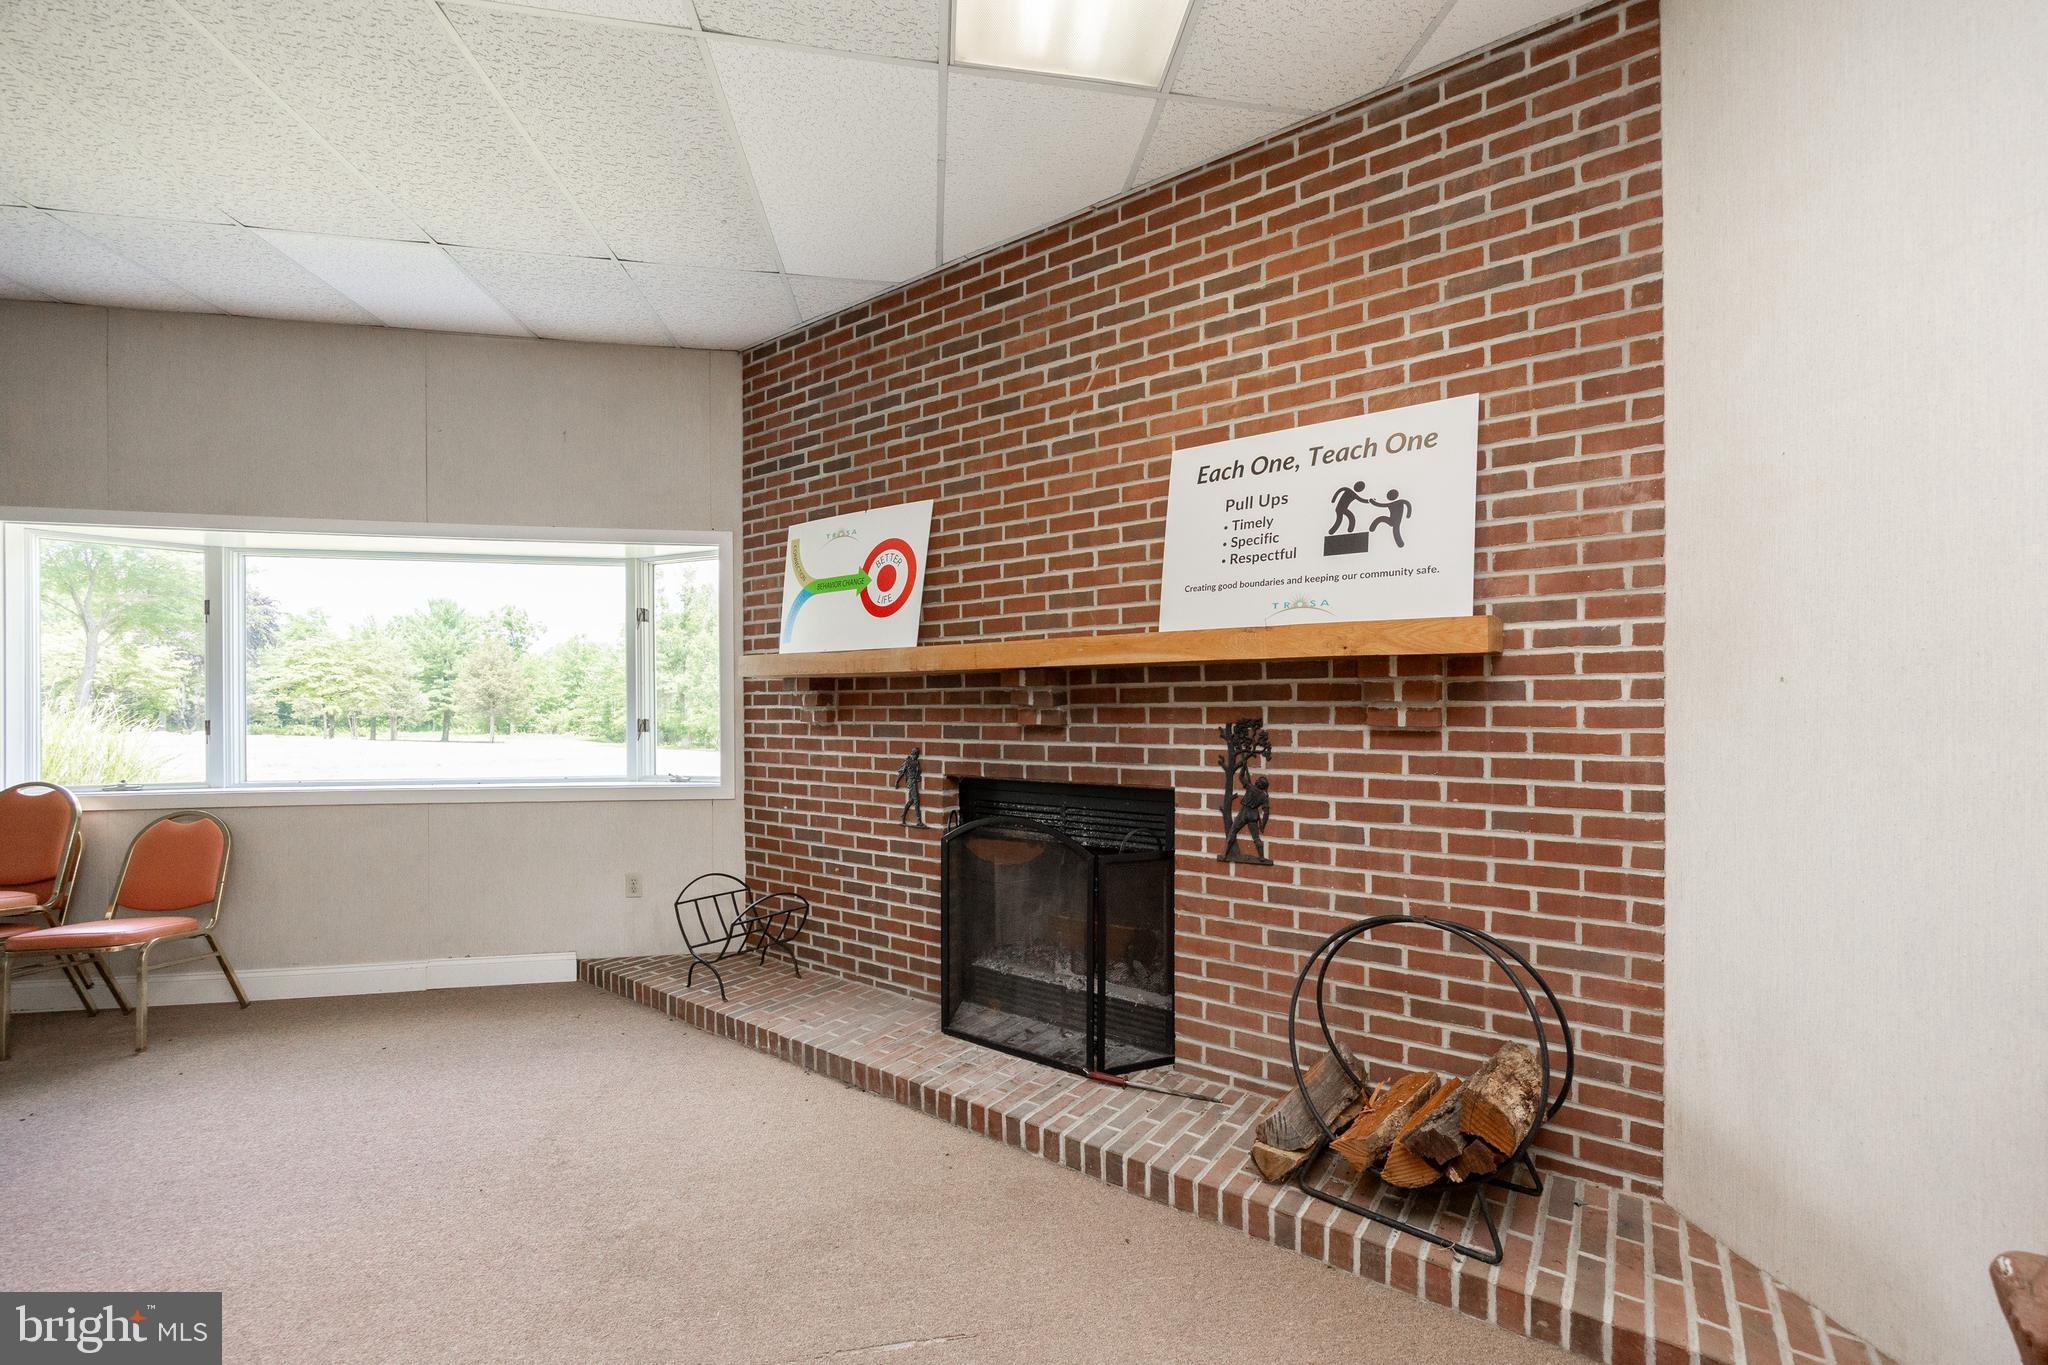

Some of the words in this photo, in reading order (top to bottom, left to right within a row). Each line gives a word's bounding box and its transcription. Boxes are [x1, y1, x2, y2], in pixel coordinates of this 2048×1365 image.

[1196, 460, 1245, 485] Each
[1250, 454, 1301, 476] One,
[1309, 437, 1377, 467] Teach
[1385, 430, 1439, 454] One
[1225, 495, 1254, 512] Pull
[1259, 492, 1289, 510] Ups
[1232, 516, 1274, 532] Timely
[1230, 532, 1280, 549] Specific
[875, 552, 903, 569] BETTER
[1229, 547, 1297, 566] Respectful
[817, 579, 842, 591] BEHAVIOR
[842, 577, 865, 588] CHANGE
[1184, 583, 1217, 594] Creating
[1217, 581, 1238, 592] good
[1239, 576, 1285, 589] boundaries
[1286, 575, 1303, 585] and
[1304, 572, 1340, 585] keeping
[1341, 571, 1358, 581] our
[1359, 567, 1414, 580] community
[1416, 565, 1440, 576] safe.
[877, 593, 893, 605] LIFE
[1271, 598, 1330, 610] TROSA
